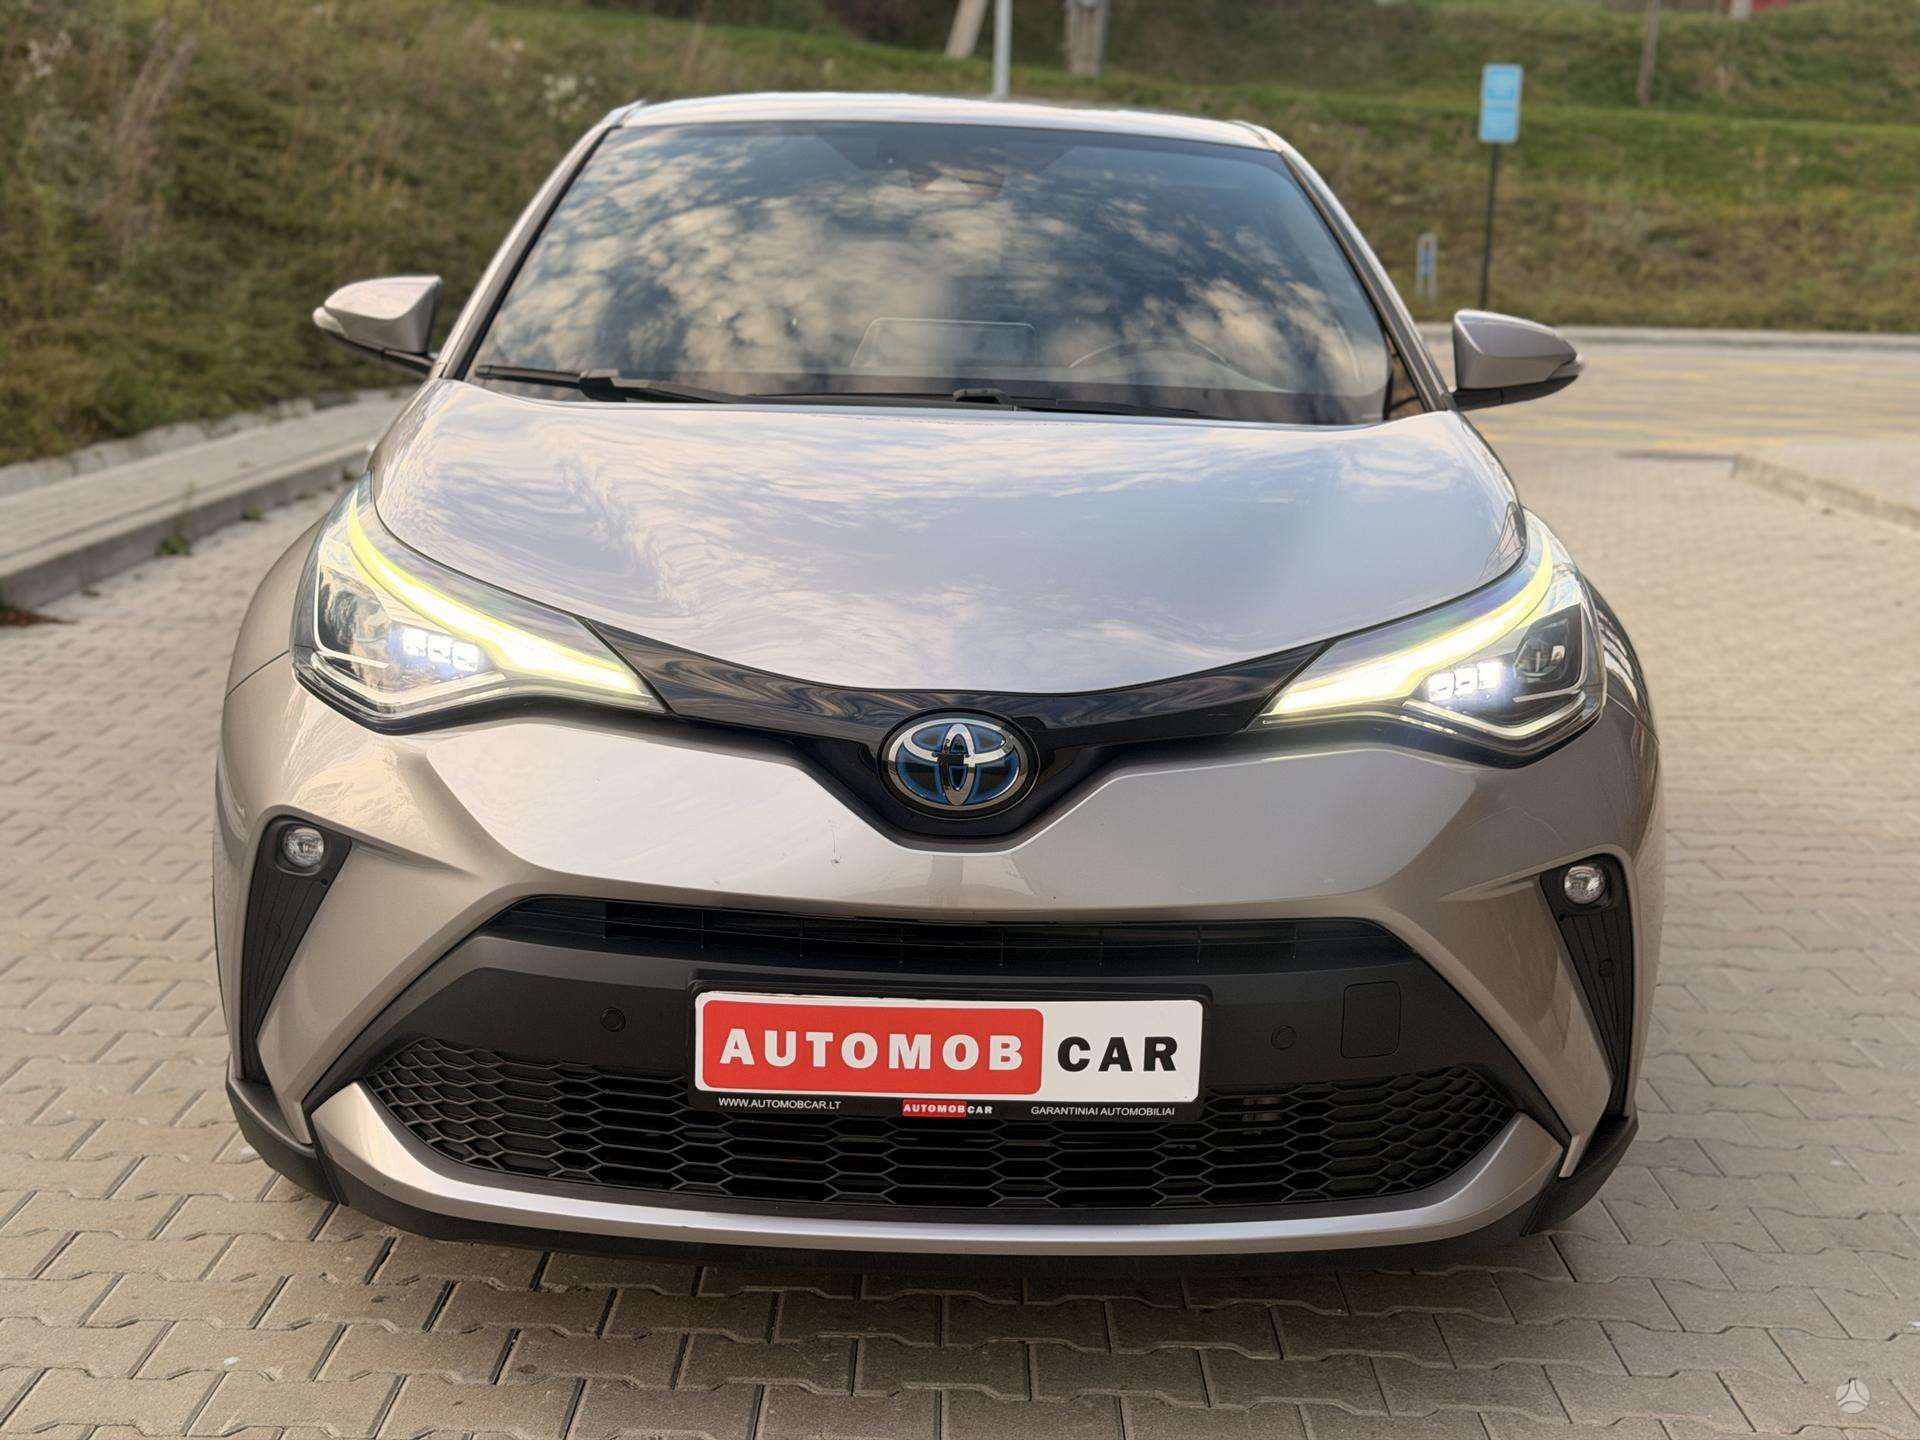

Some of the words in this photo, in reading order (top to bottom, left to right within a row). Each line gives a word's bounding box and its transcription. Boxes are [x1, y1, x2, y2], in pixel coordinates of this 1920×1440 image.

[719, 1028, 1023, 1070] AUTOMOB
[1057, 1036, 1178, 1072] CAR
[718, 1097, 841, 1110] WWW.AUTOMOBCAR.LT
[1030, 1106, 1098, 1117] GARANTINIAI
[1100, 1107, 1175, 1117] AUTOMOBILIAI
